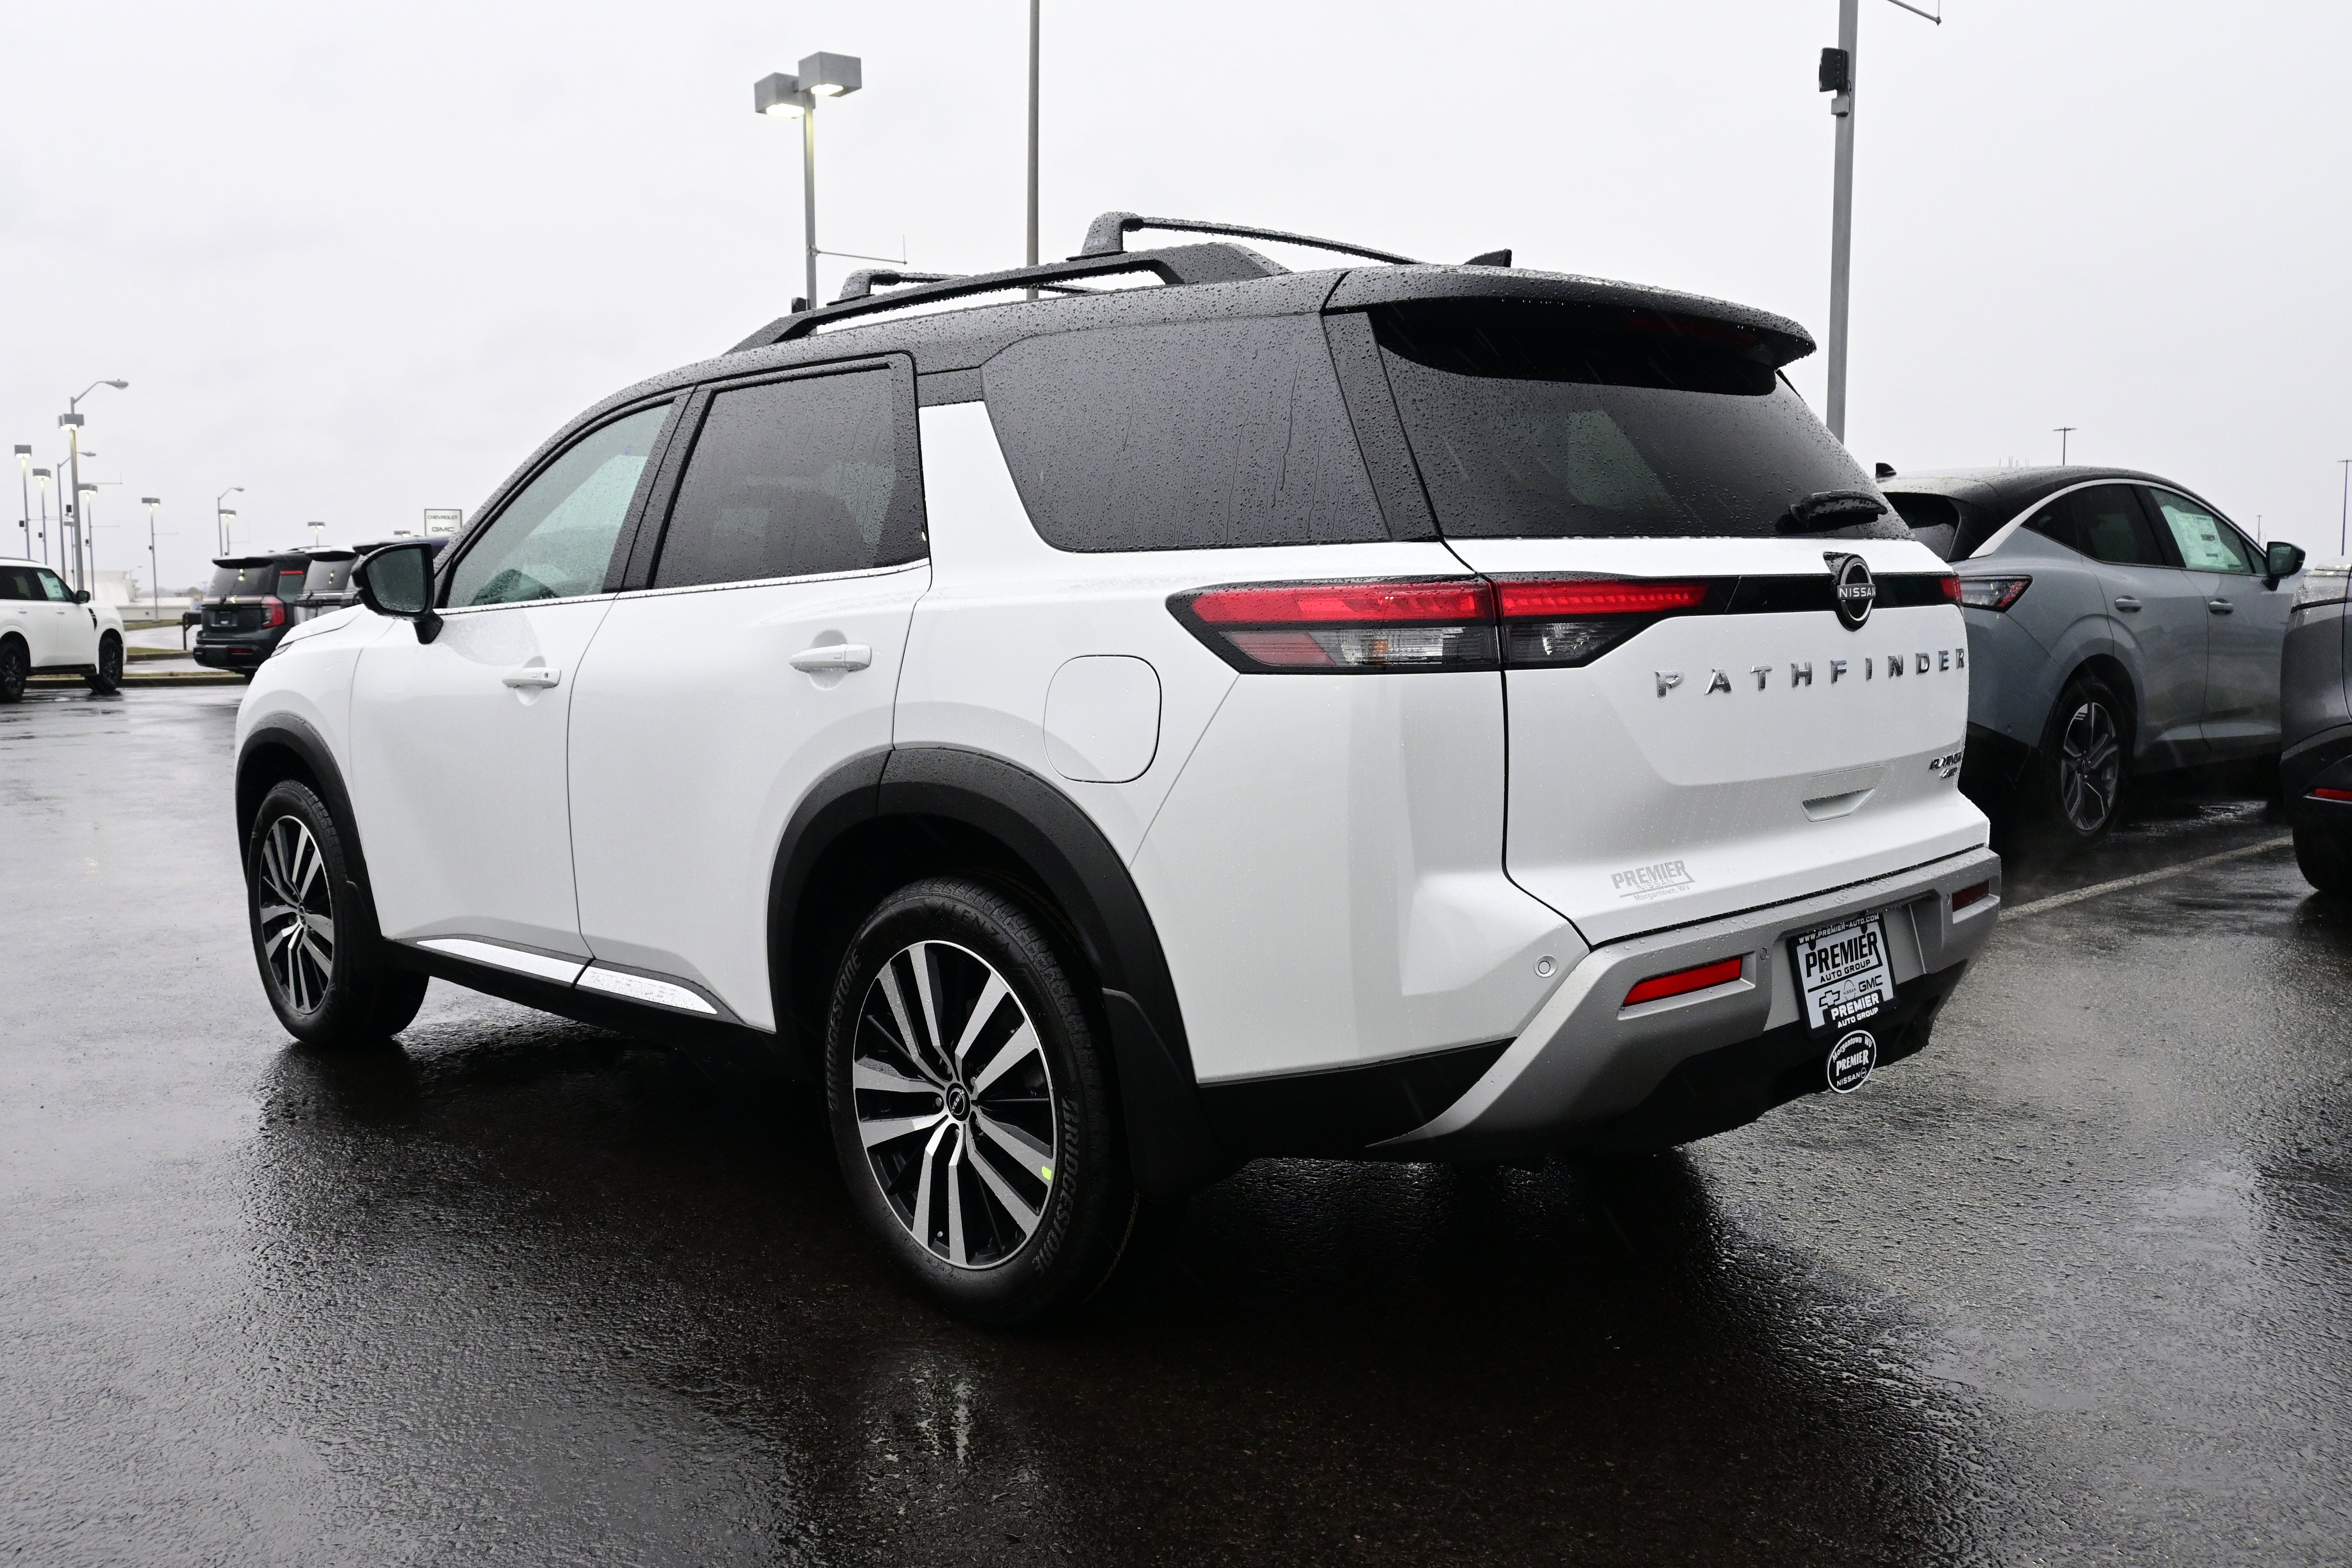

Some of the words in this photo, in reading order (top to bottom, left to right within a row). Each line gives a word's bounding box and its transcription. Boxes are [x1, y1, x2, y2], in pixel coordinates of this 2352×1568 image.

[1839, 587, 1876, 598] NISSAN
[1655, 648, 1965, 698] PATHFINDER
[1611, 860, 1694, 889] PREMIER
[1636, 878, 1674, 890] NISSAN
[1633, 887, 1679, 901] Morgantown,
[1677, 884, 1690, 893] WV
[1799, 912, 1879, 944] WWW.PREMIER-AUTO.COM
[1805, 931, 1882, 977] PREMIER
[1821, 970, 1842, 983] AUTO
[1844, 959, 1870, 974] GROUP
[1859, 975, 1883, 992] GMC
[1831, 993, 1879, 1021] PREMIER
[1838, 1016, 1856, 1028] AUTO
[1857, 1007, 1878, 1021] GROUP
[1832, 1037, 1862, 1063] Morgantown
[1865, 1036, 1873, 1048] WV
[1836, 1049, 1869, 1077] PREMIER
[1837, 1072, 1860, 1087] NISSAN
[950, 1089, 965, 1115] NISSAN
[1032, 1096, 1081, 1277] BRIDGESTONE
